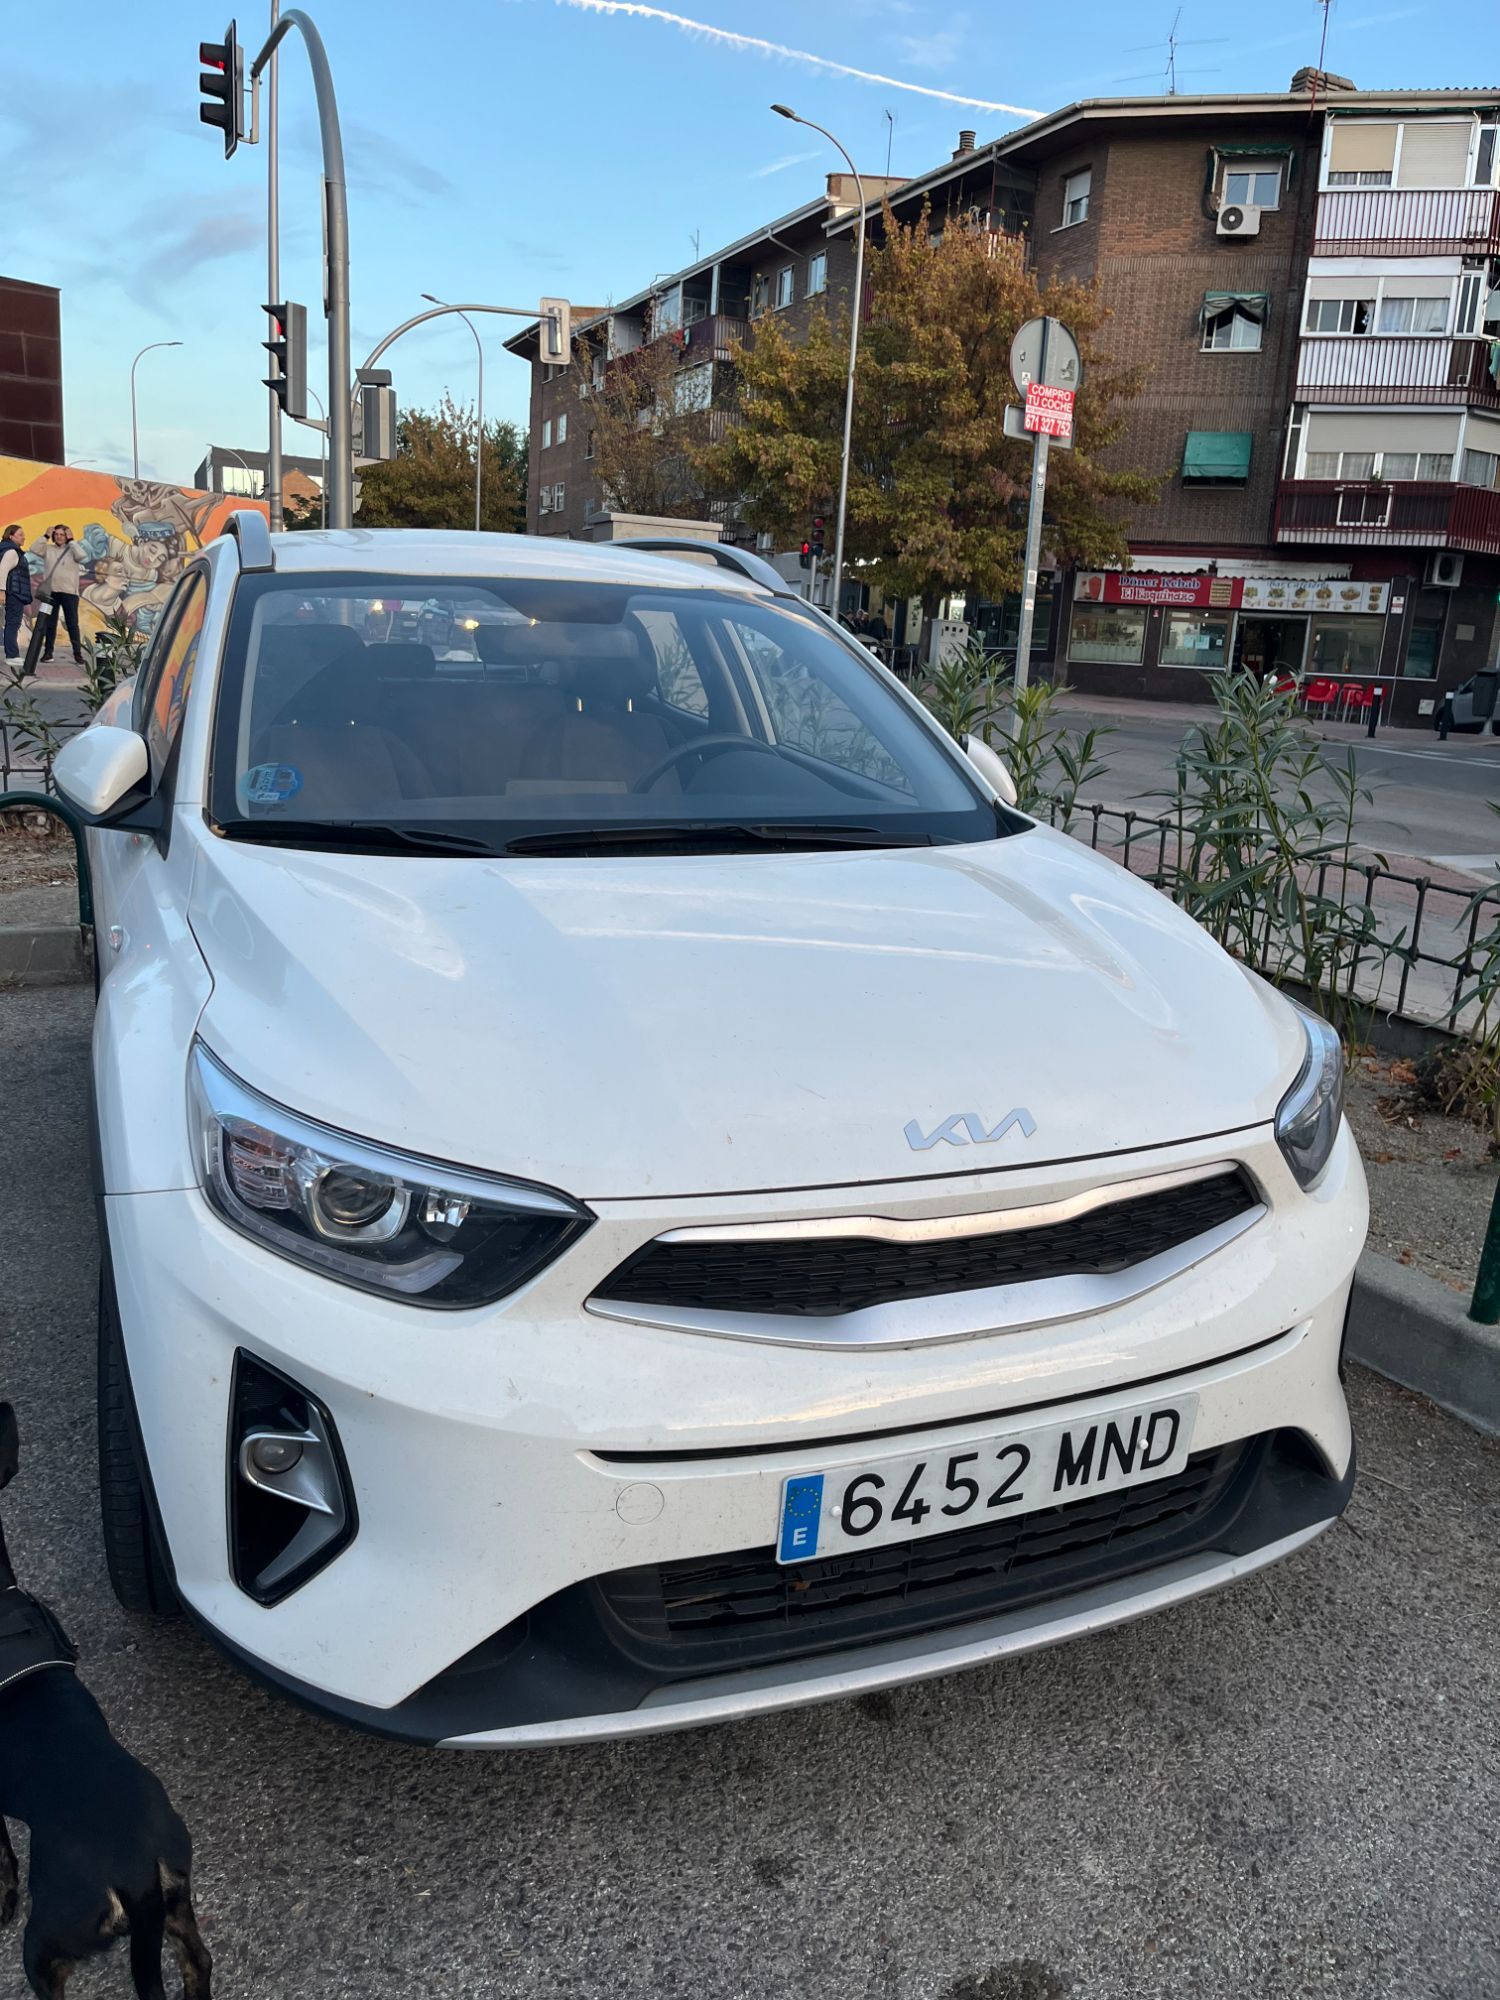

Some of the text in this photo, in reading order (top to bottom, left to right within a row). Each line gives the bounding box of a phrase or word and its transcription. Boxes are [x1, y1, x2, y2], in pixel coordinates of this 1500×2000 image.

[1032, 384, 1071, 401] COMPRO
[1028, 394, 1040, 406] TU
[1041, 397, 1072, 413] COCHE
[1025, 414, 1071, 436] 671 327 752
[1160, 576, 1200, 589] Kebab
[1121, 587, 1134, 600] El
[903, 1107, 1038, 1151] KIA
[840, 1409, 1181, 1537] 6452 MND
[792, 1526, 808, 1546] E
